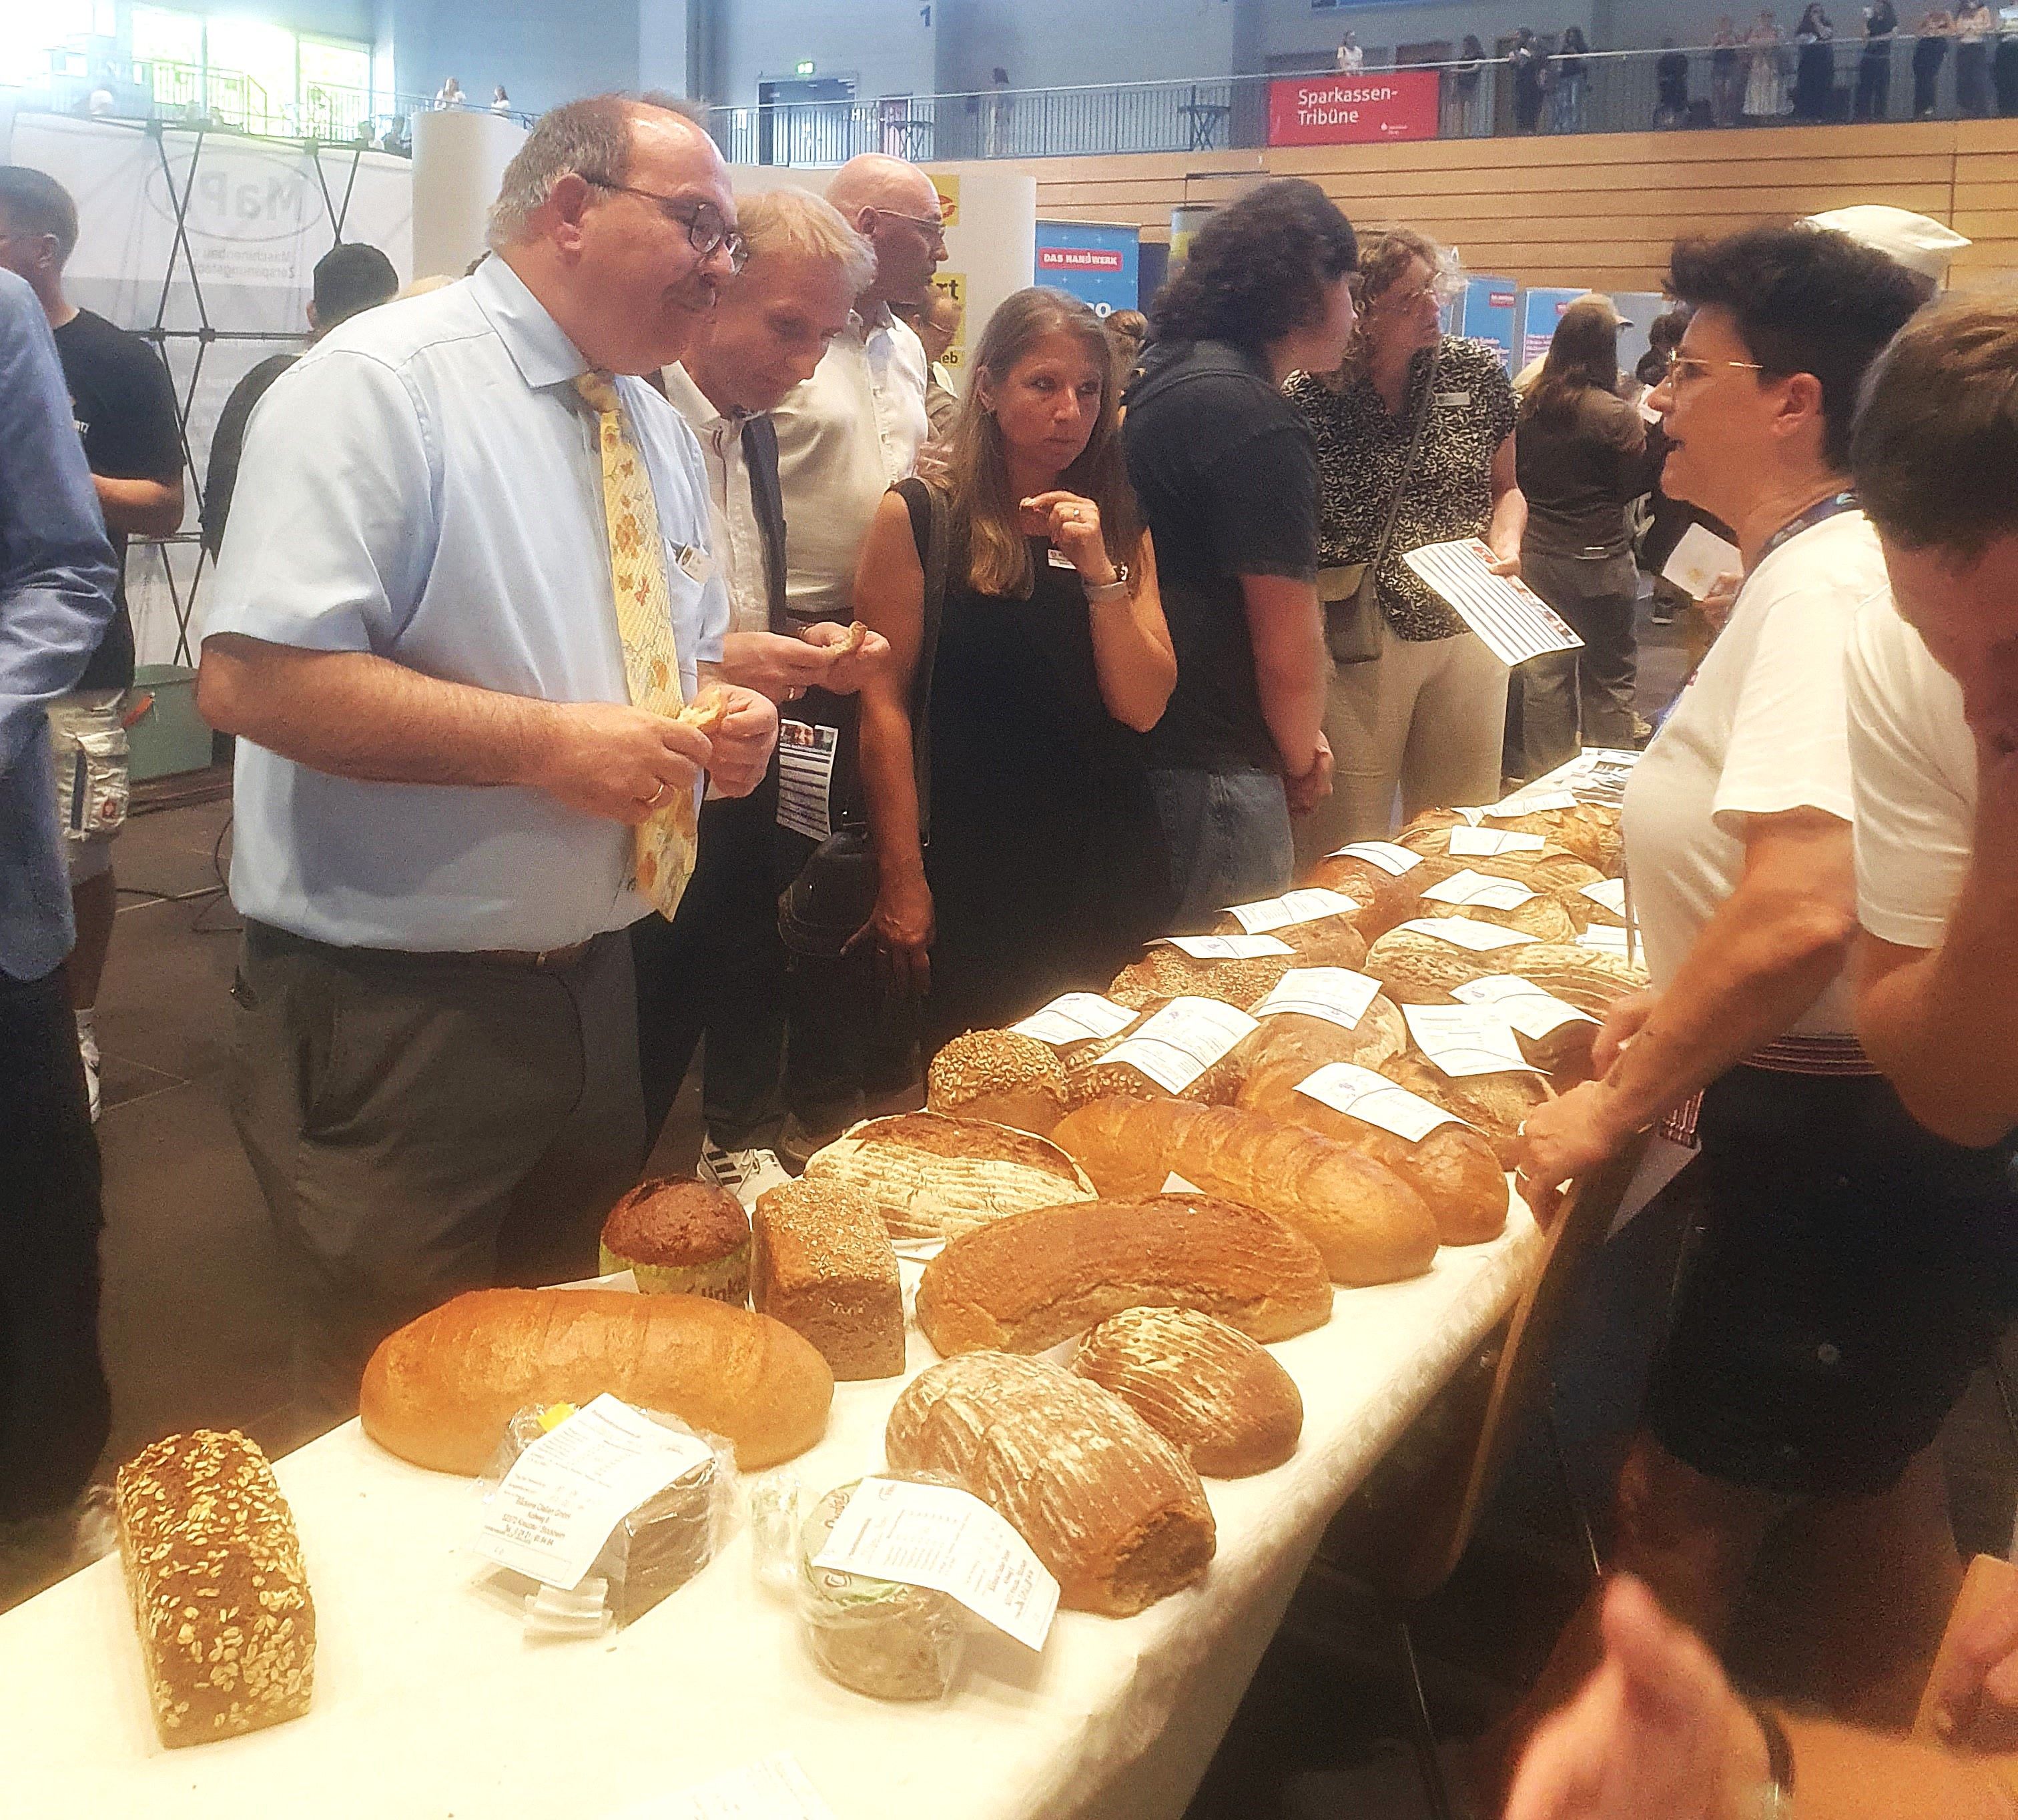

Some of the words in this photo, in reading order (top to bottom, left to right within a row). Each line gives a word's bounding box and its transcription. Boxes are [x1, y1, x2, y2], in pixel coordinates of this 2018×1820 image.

[920, 5, 930, 27] 1
[1297, 86, 1399, 108] Sparkassen-
[1297, 107, 1359, 125] Tribüne
[1043, 253, 1064, 263] DAS
[942, 352, 959, 364] eb
